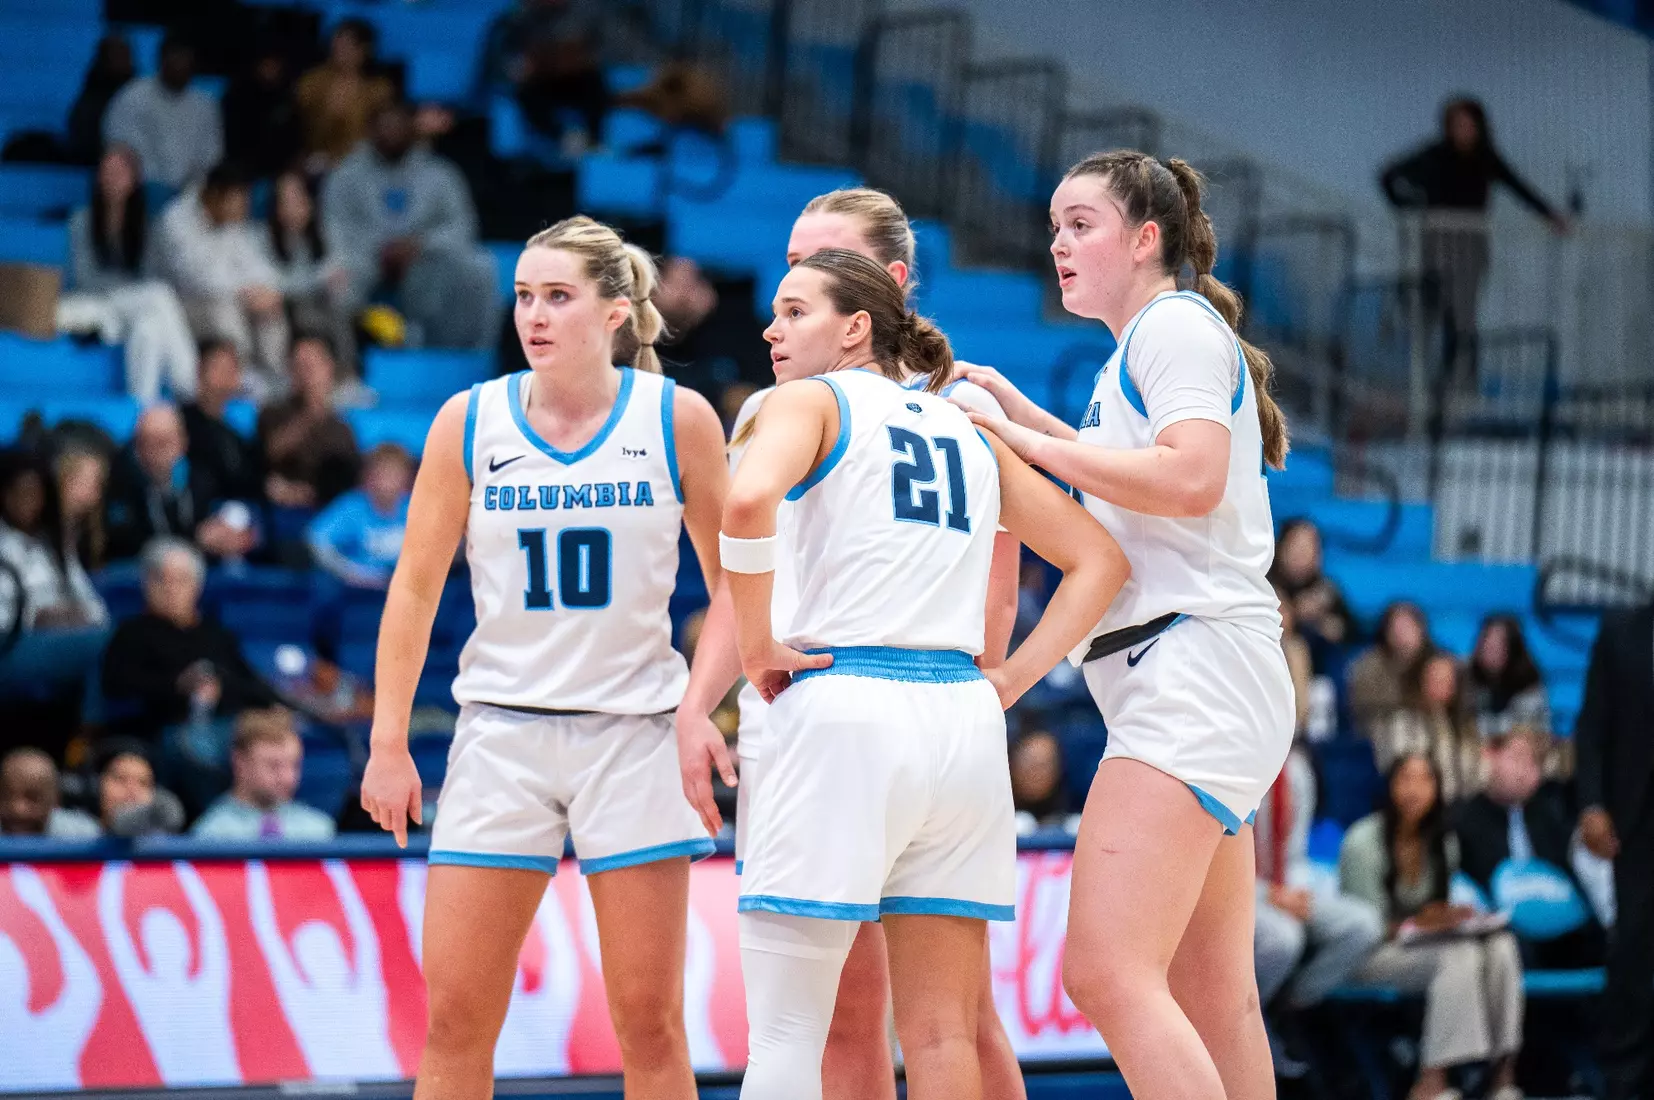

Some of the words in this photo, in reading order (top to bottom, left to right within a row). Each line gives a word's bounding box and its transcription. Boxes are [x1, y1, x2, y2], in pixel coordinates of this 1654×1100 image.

[484, 481, 654, 510] COLUMBIA
[885, 424, 971, 535] 21
[517, 526, 612, 611] 10
